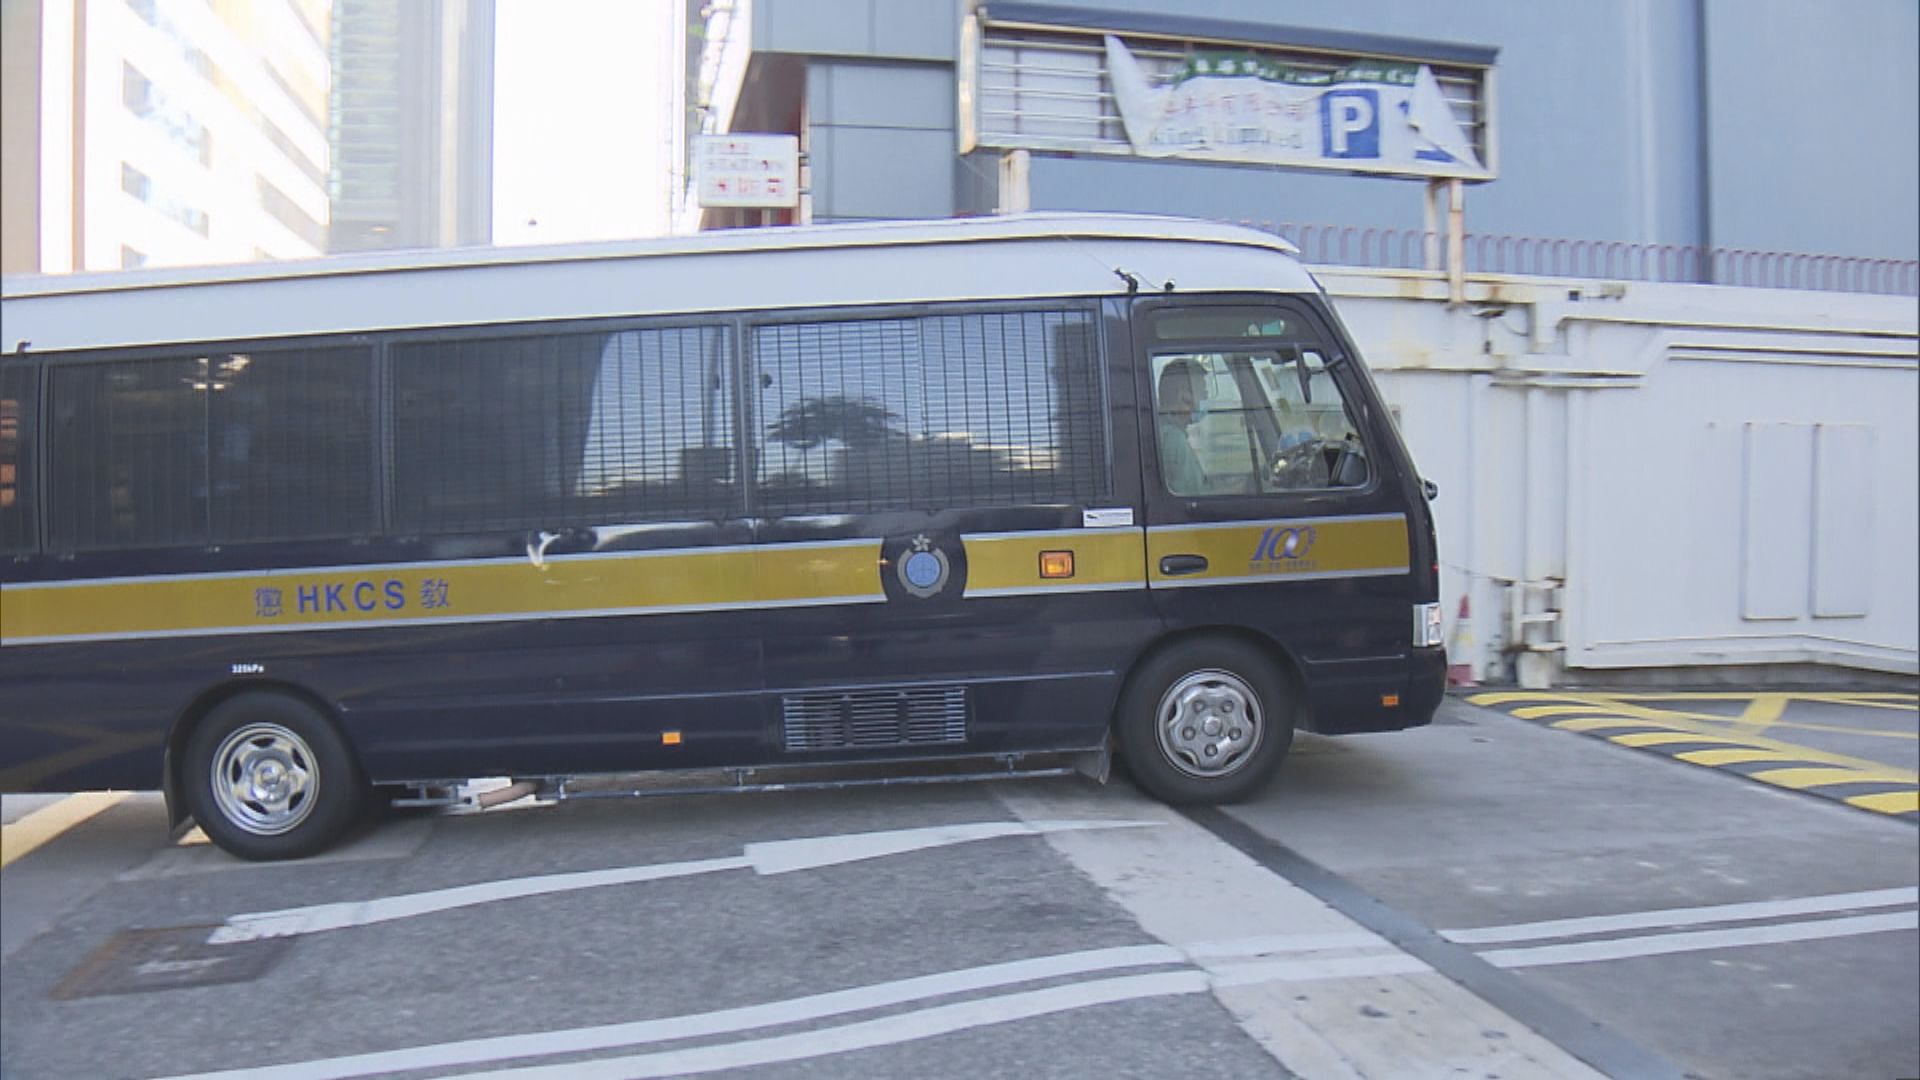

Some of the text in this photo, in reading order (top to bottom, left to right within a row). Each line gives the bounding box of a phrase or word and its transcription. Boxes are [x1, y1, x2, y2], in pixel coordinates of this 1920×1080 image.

[1328, 95, 1374, 153] P
[1250, 525, 1317, 561] 100
[298, 580, 405, 613] HKCS
